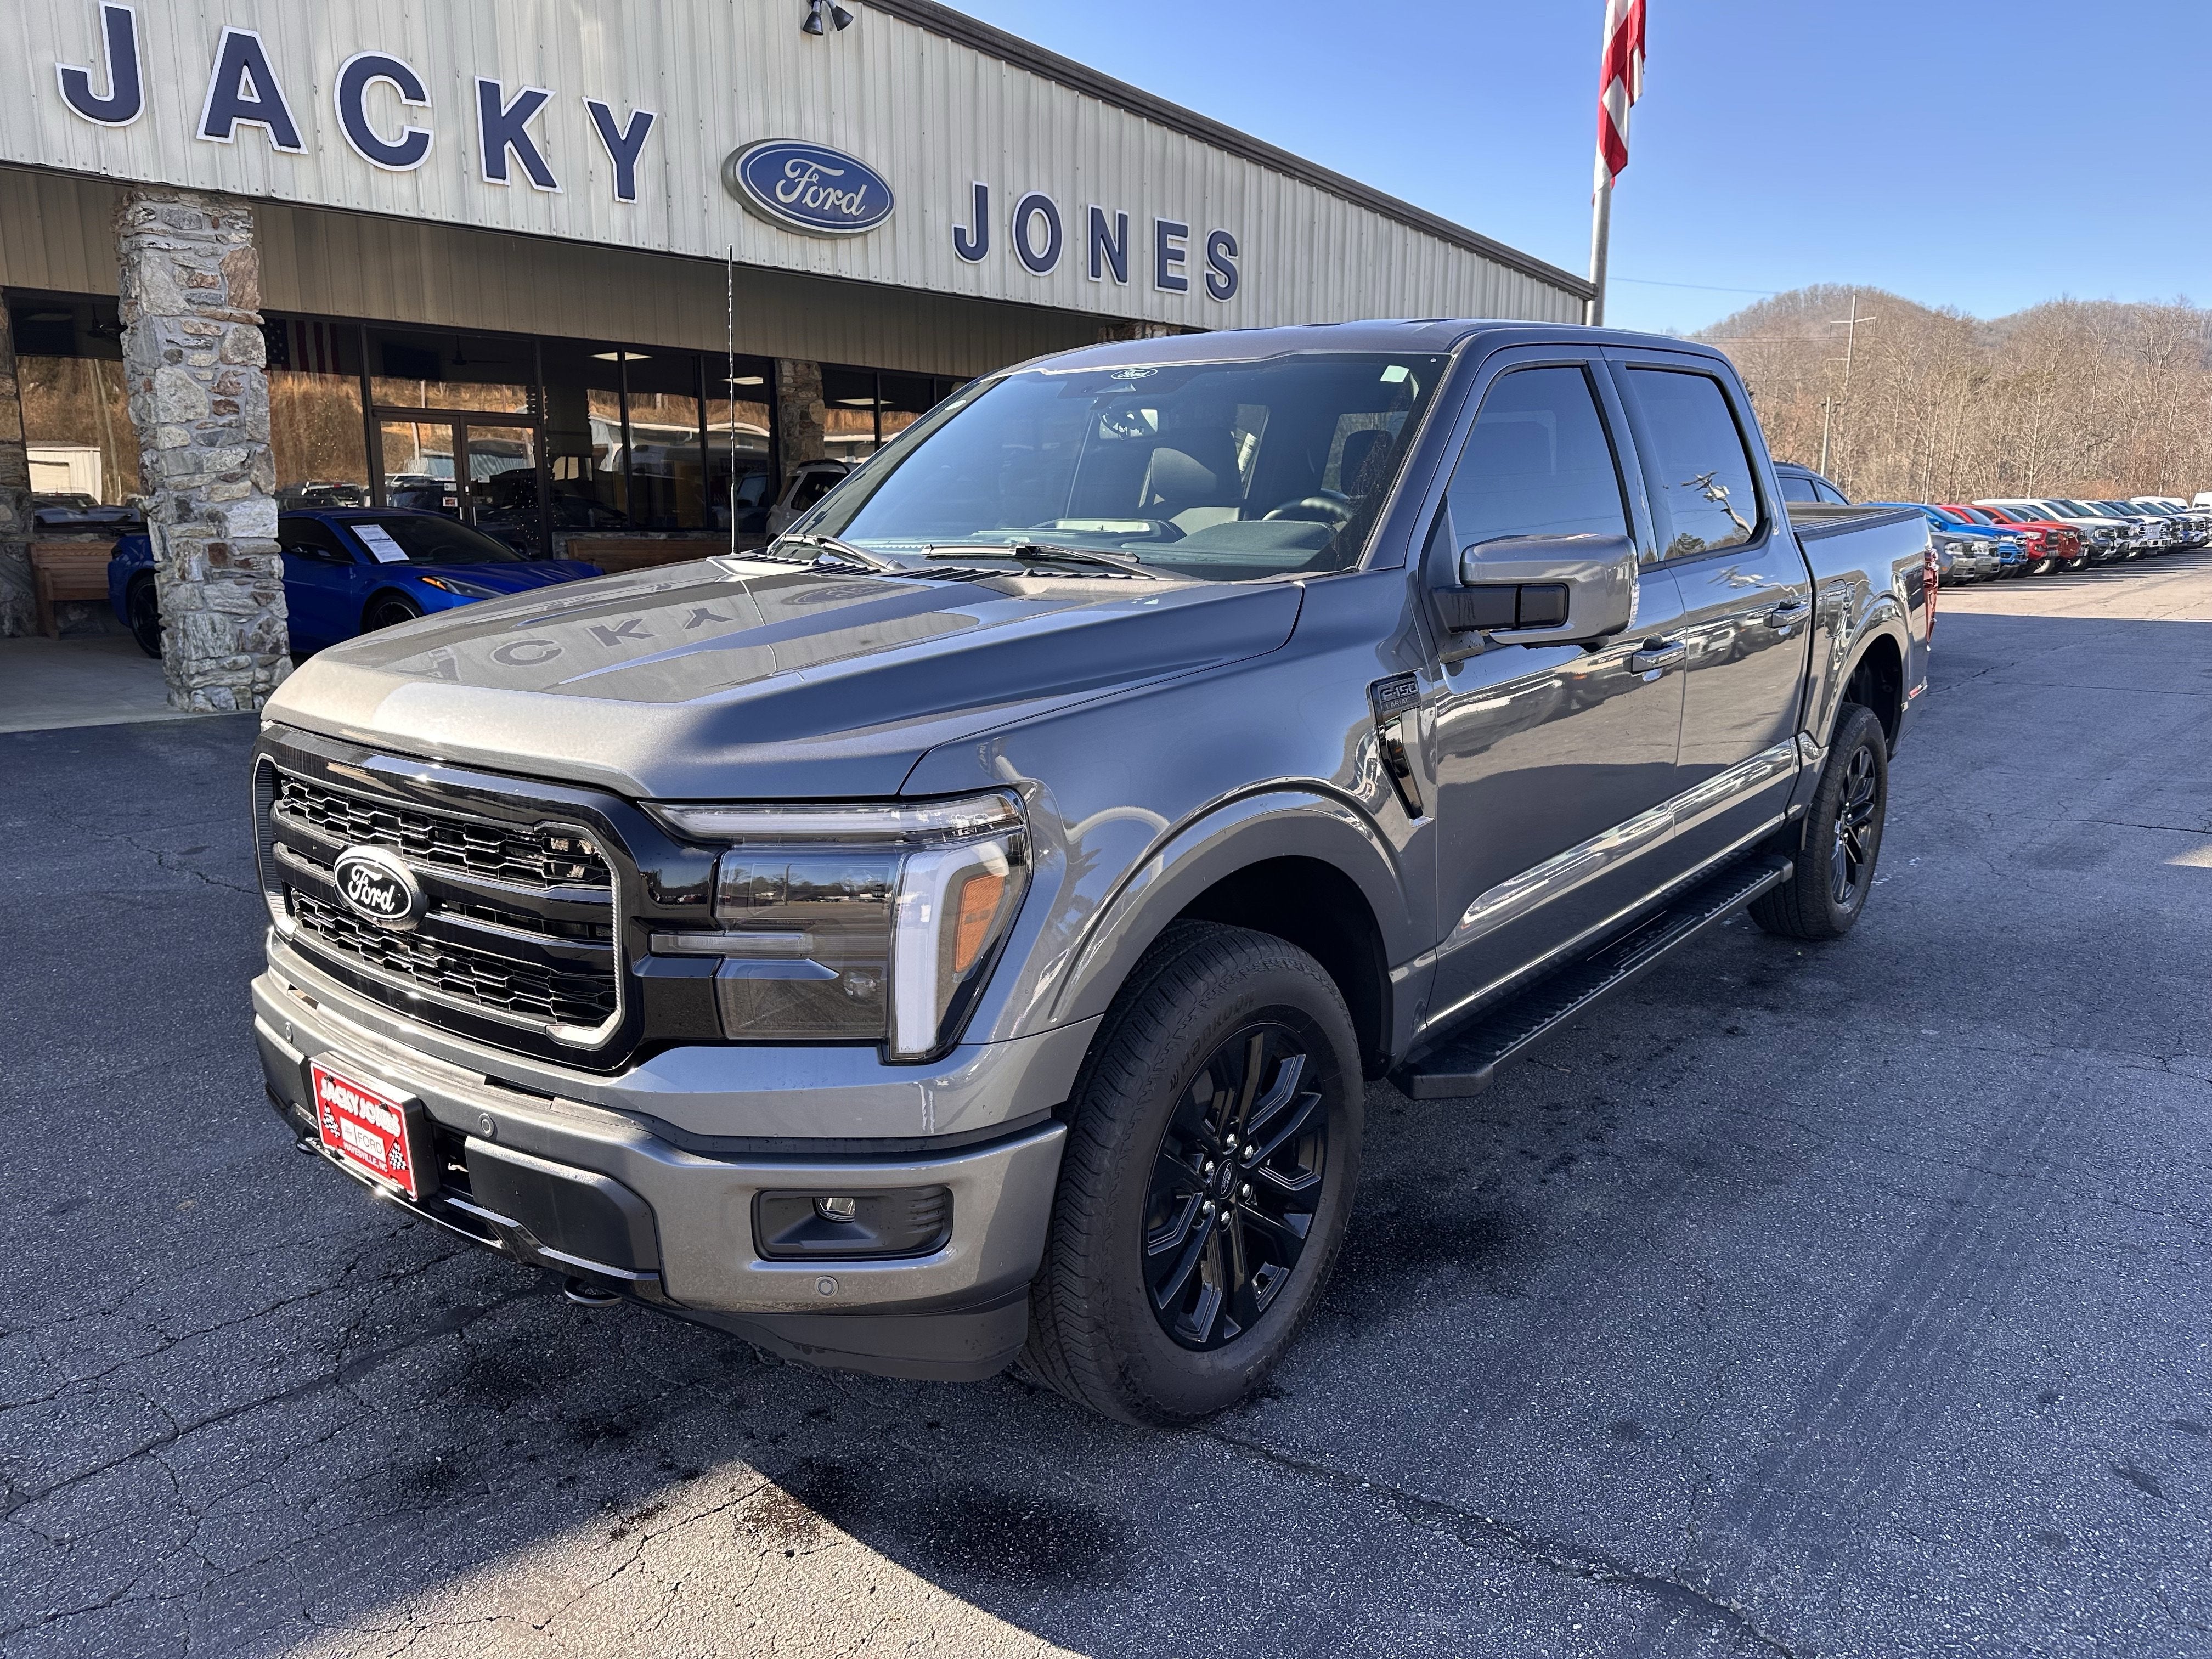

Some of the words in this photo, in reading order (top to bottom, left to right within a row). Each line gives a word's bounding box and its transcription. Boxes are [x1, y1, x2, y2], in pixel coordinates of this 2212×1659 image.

[56, 1, 658, 204] JACKY
[951, 180, 1239, 303] JONES
[775, 158, 867, 217] Ford
[1117, 369, 1151, 378] Ford
[1381, 681, 1419, 701] F-150
[1386, 698, 1408, 709] LARIAT
[348, 865, 395, 912] Ford
[320, 1076, 359, 1116] JACKY
[359, 1097, 402, 1138] JONES
[358, 1132, 382, 1154] FORD
[379, 1160, 388, 1173] NC
